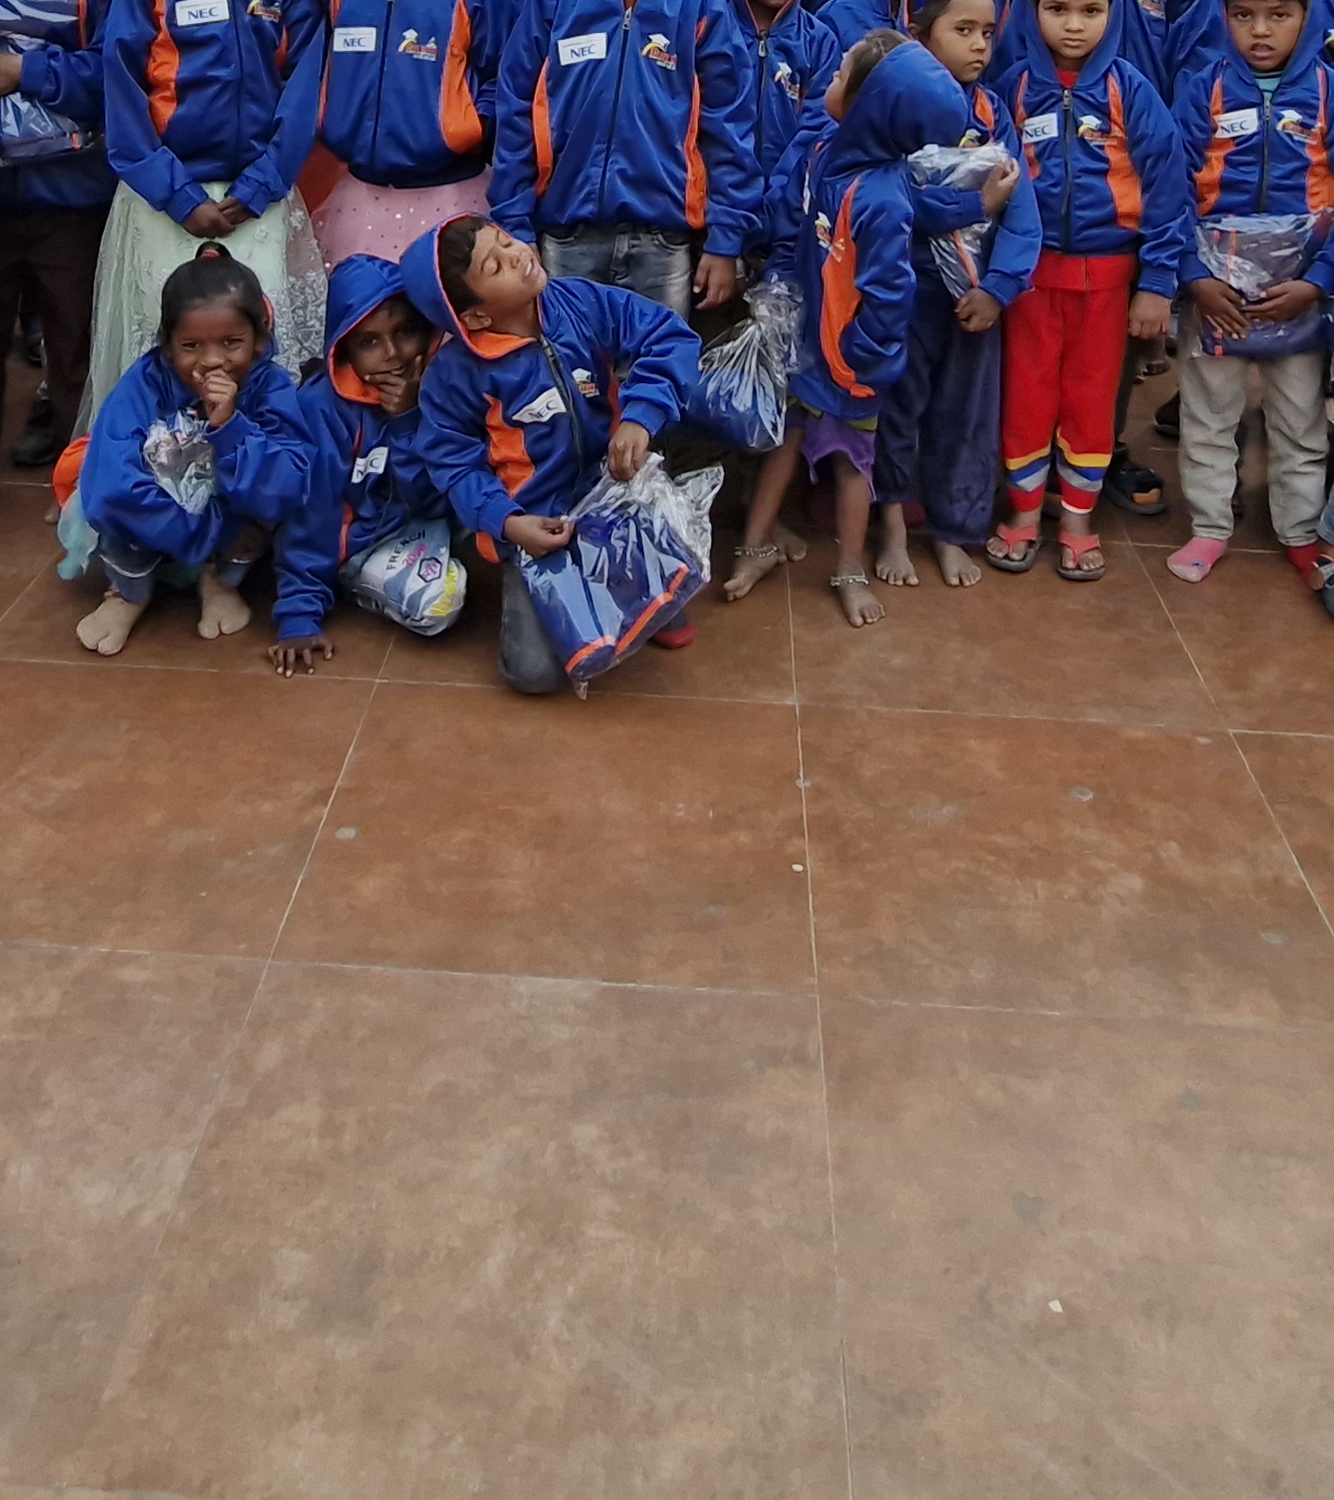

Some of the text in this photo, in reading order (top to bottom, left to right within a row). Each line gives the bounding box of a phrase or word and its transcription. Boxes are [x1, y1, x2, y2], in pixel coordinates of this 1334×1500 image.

[187, 7, 219, 20] NEC
[343, 37, 366, 48] NEC
[570, 44, 597, 59] NEC
[1024, 124, 1051, 139] NEC
[1220, 121, 1250, 134] NEC
